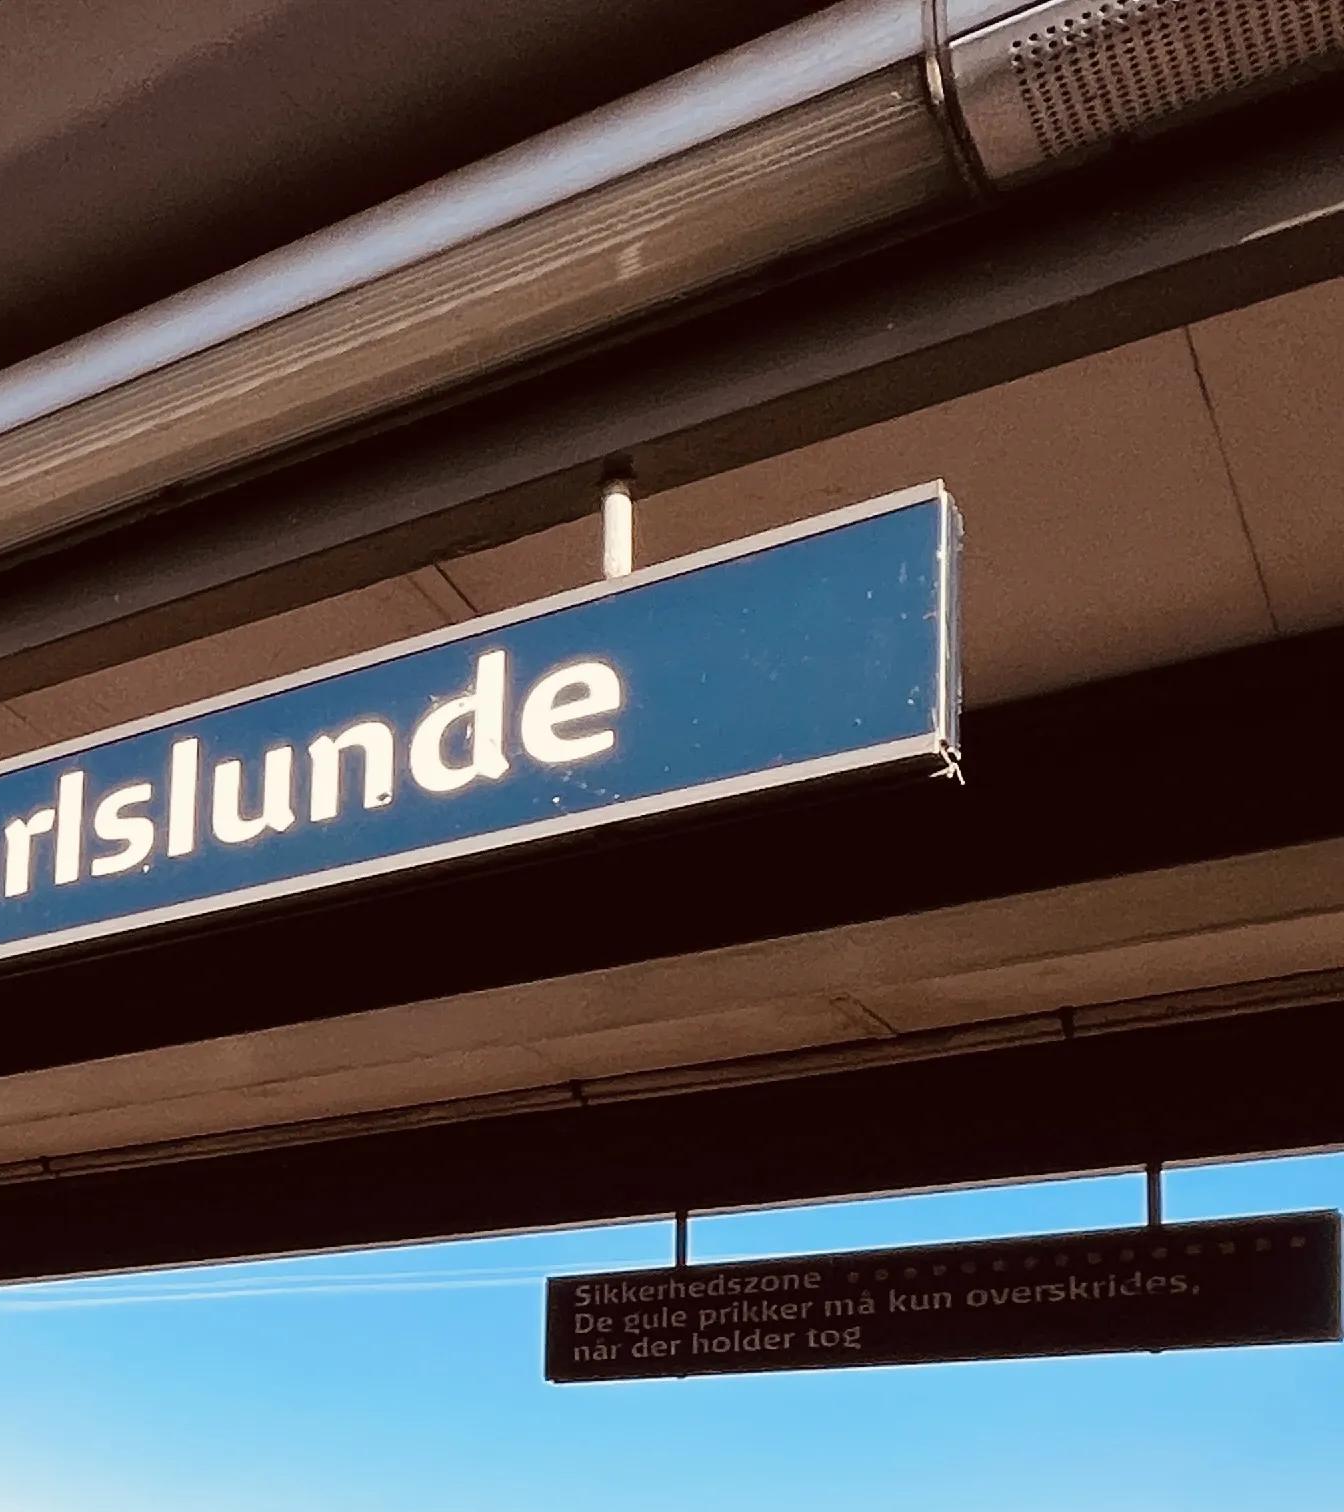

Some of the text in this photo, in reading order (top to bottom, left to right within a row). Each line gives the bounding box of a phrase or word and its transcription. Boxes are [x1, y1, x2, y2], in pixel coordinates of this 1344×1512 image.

[574, 1270, 822, 1308] Sikkerhedszone
[574, 1312, 613, 1334] De
[623, 1306, 688, 1335] gule
[699, 1299, 814, 1329] prikker
[823, 1289, 876, 1318] må
[888, 1288, 953, 1314] kun
[574, 1326, 862, 1362] når der holder tog
